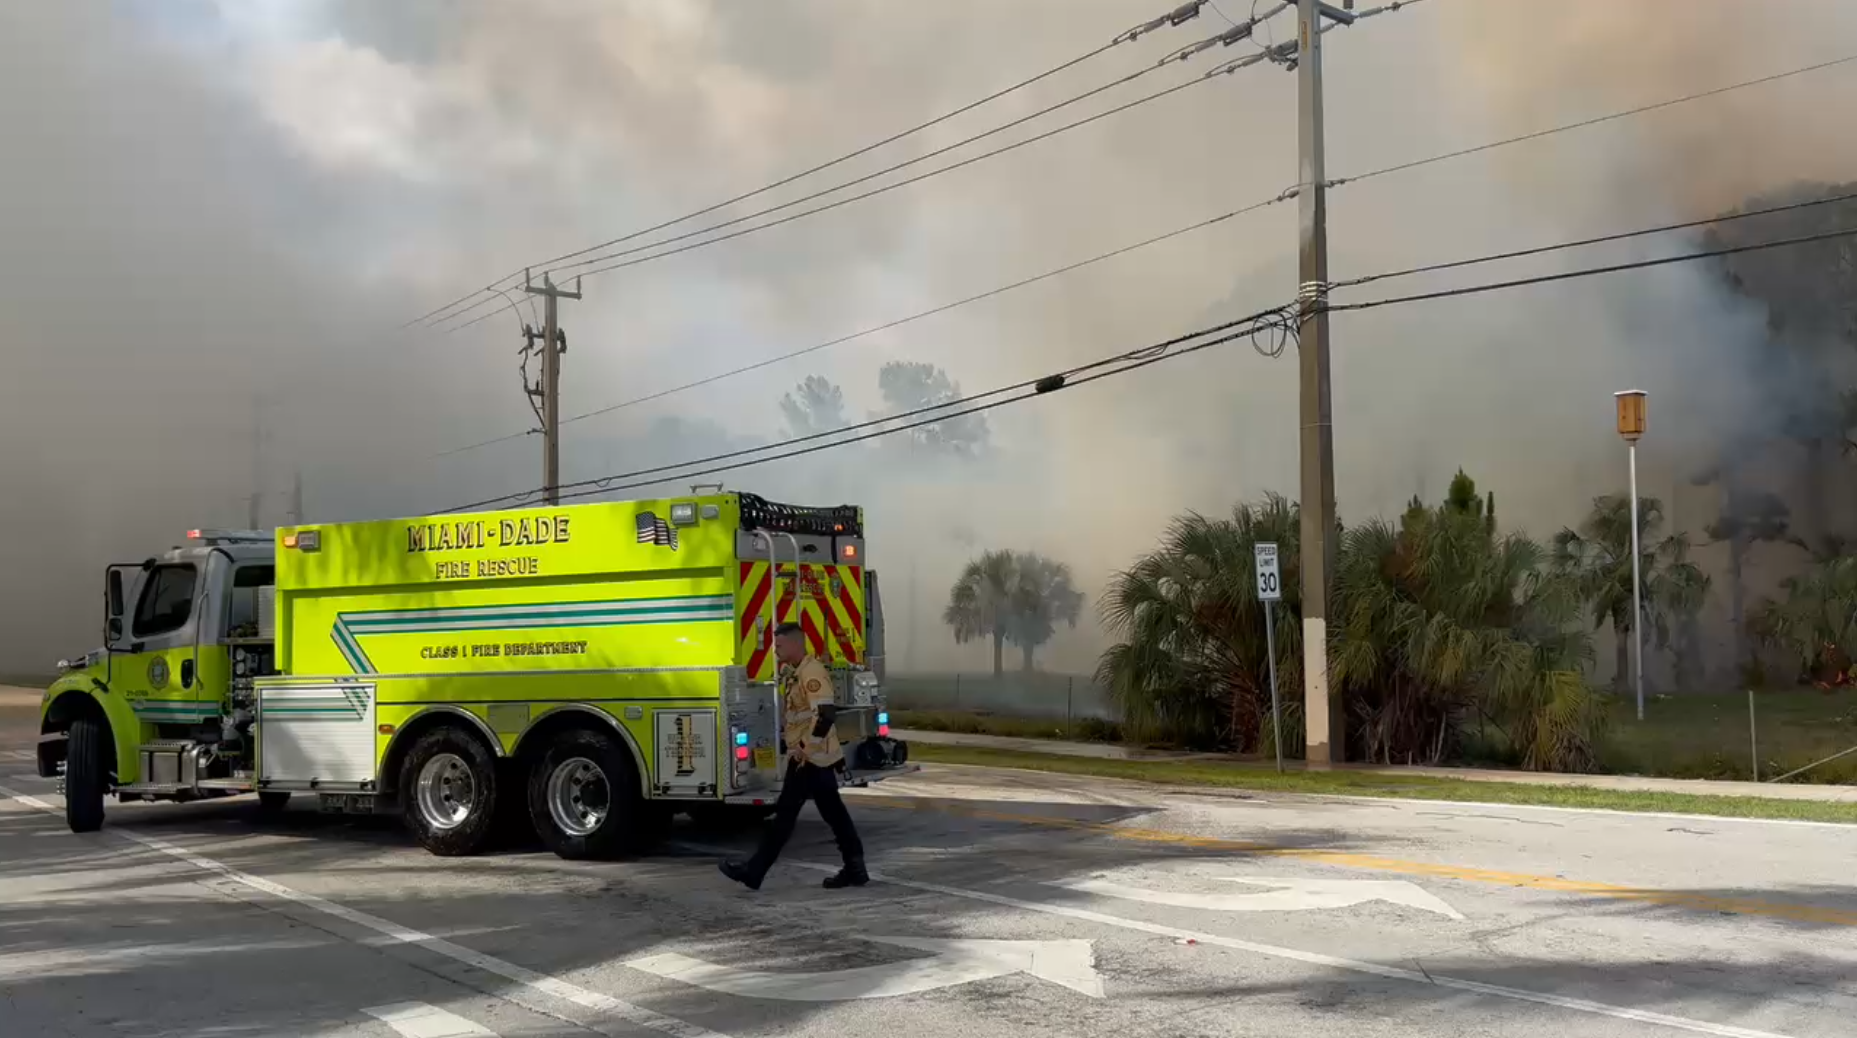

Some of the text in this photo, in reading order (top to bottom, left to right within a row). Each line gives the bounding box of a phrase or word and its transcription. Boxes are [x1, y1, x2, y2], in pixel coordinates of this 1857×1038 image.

[408, 515, 570, 553] MIAMI-DADE
[1257, 546, 1276, 556] SPEED
[436, 556, 538, 579] FIRE RESCUE
[1260, 572, 1277, 592] 30
[420, 646, 458, 659] CLASS
[471, 644, 500, 657] FIRE
[504, 641, 587, 656] DEPARTMENT
